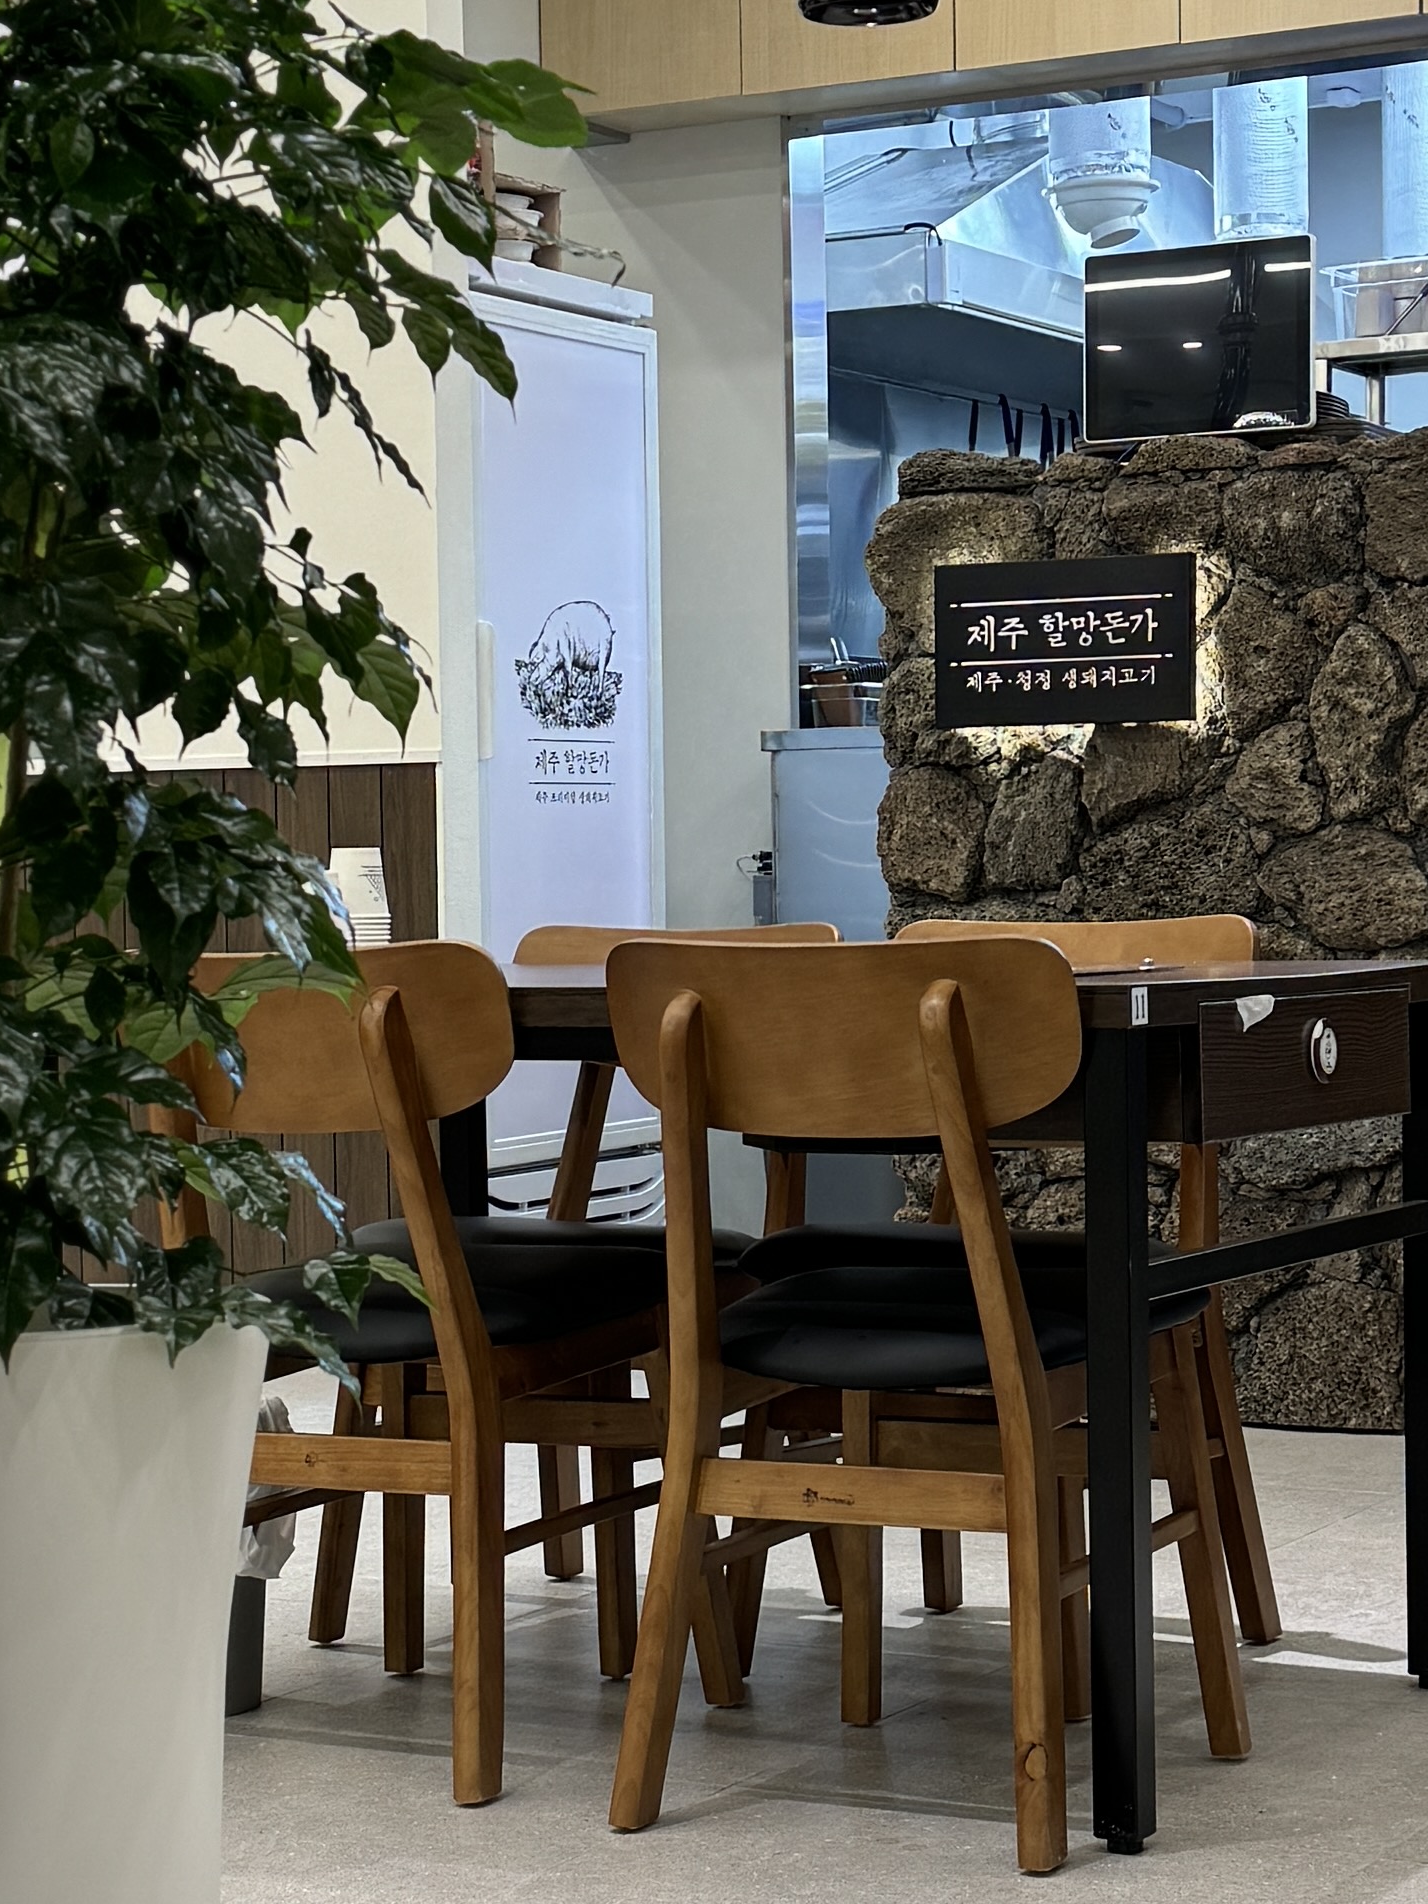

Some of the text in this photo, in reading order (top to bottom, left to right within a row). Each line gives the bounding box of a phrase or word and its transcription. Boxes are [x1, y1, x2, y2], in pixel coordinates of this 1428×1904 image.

[967, 607, 1159, 652] 제주 할망돈가
[1061, 665, 1156, 690] 생돼지고기
[535, 748, 560, 775] 제주
